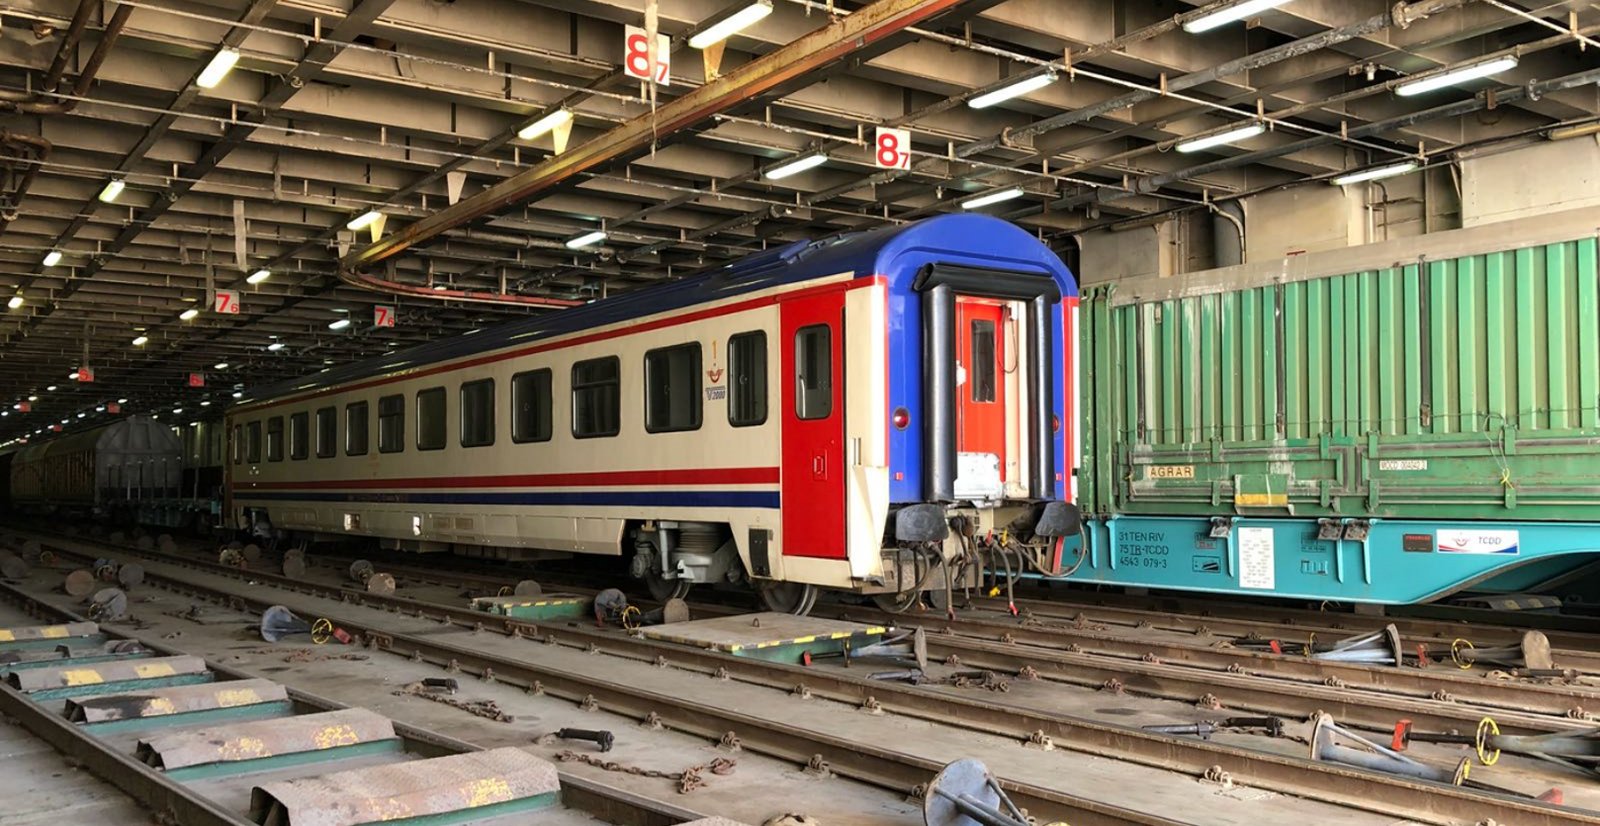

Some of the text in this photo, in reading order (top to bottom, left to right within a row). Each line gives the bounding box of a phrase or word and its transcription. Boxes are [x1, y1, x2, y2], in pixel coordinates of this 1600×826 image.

[626, 34, 668, 82] 8 7
[877, 133, 909, 168] 8 7
[217, 294, 239, 313] 7 6
[375, 308, 394, 327] 7 6
[1150, 467, 1192, 477] AGRAR
[1119, 532, 1165, 542] 31 TEN RIV
[1478, 536, 1501, 545] TCDD
[1143, 558, 1167, 568] 079-3
